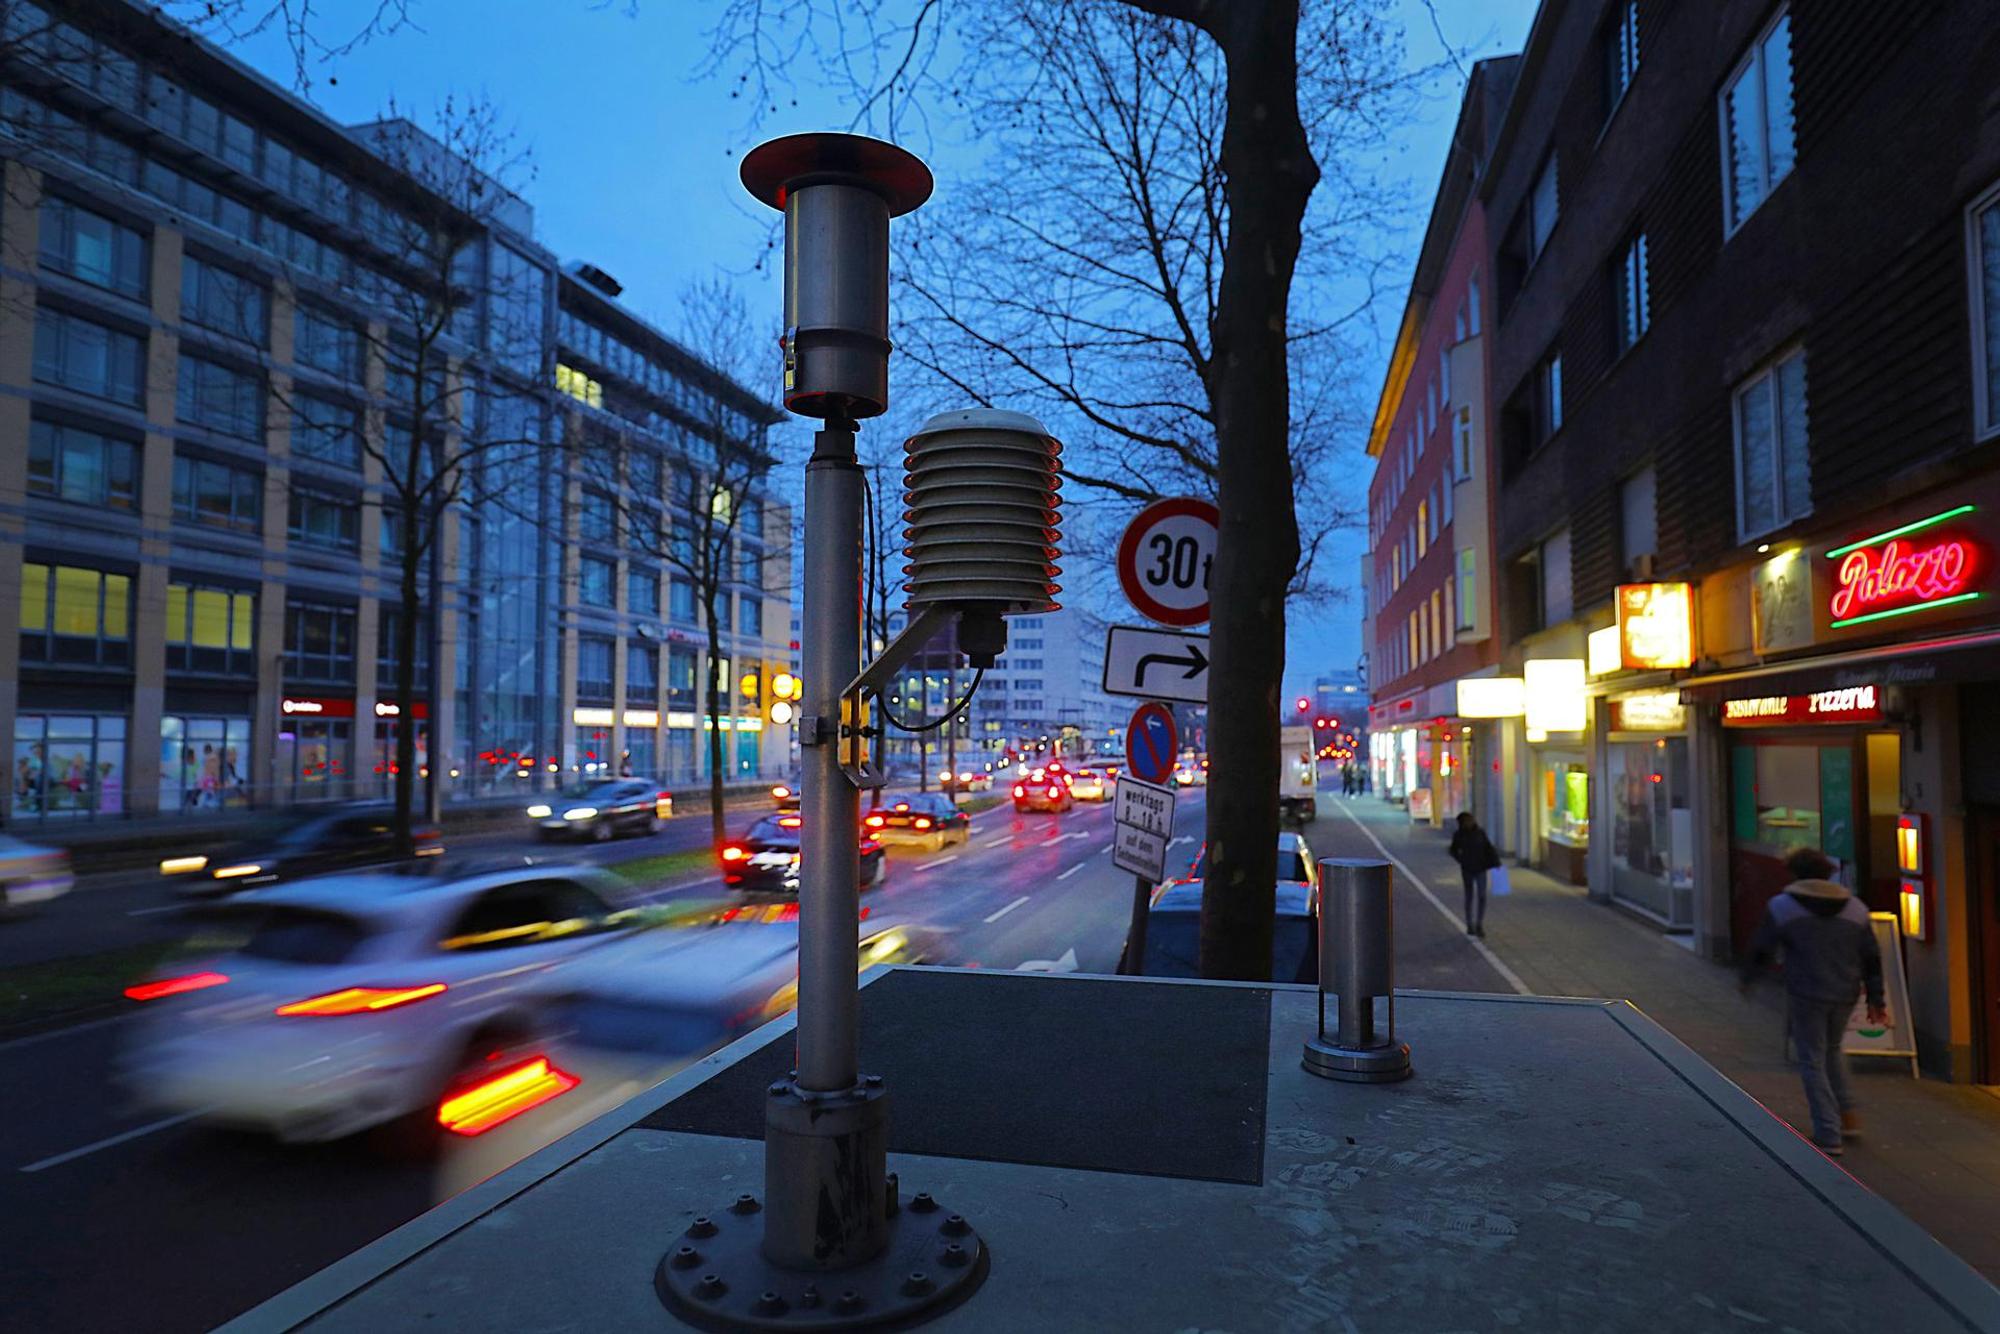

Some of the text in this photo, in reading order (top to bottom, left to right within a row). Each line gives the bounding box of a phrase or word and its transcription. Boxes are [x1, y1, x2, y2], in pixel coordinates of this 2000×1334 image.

[1147, 533, 1199, 589] 30
[1831, 541, 1964, 618] Palazzo
[1126, 790, 1164, 815] werktags
